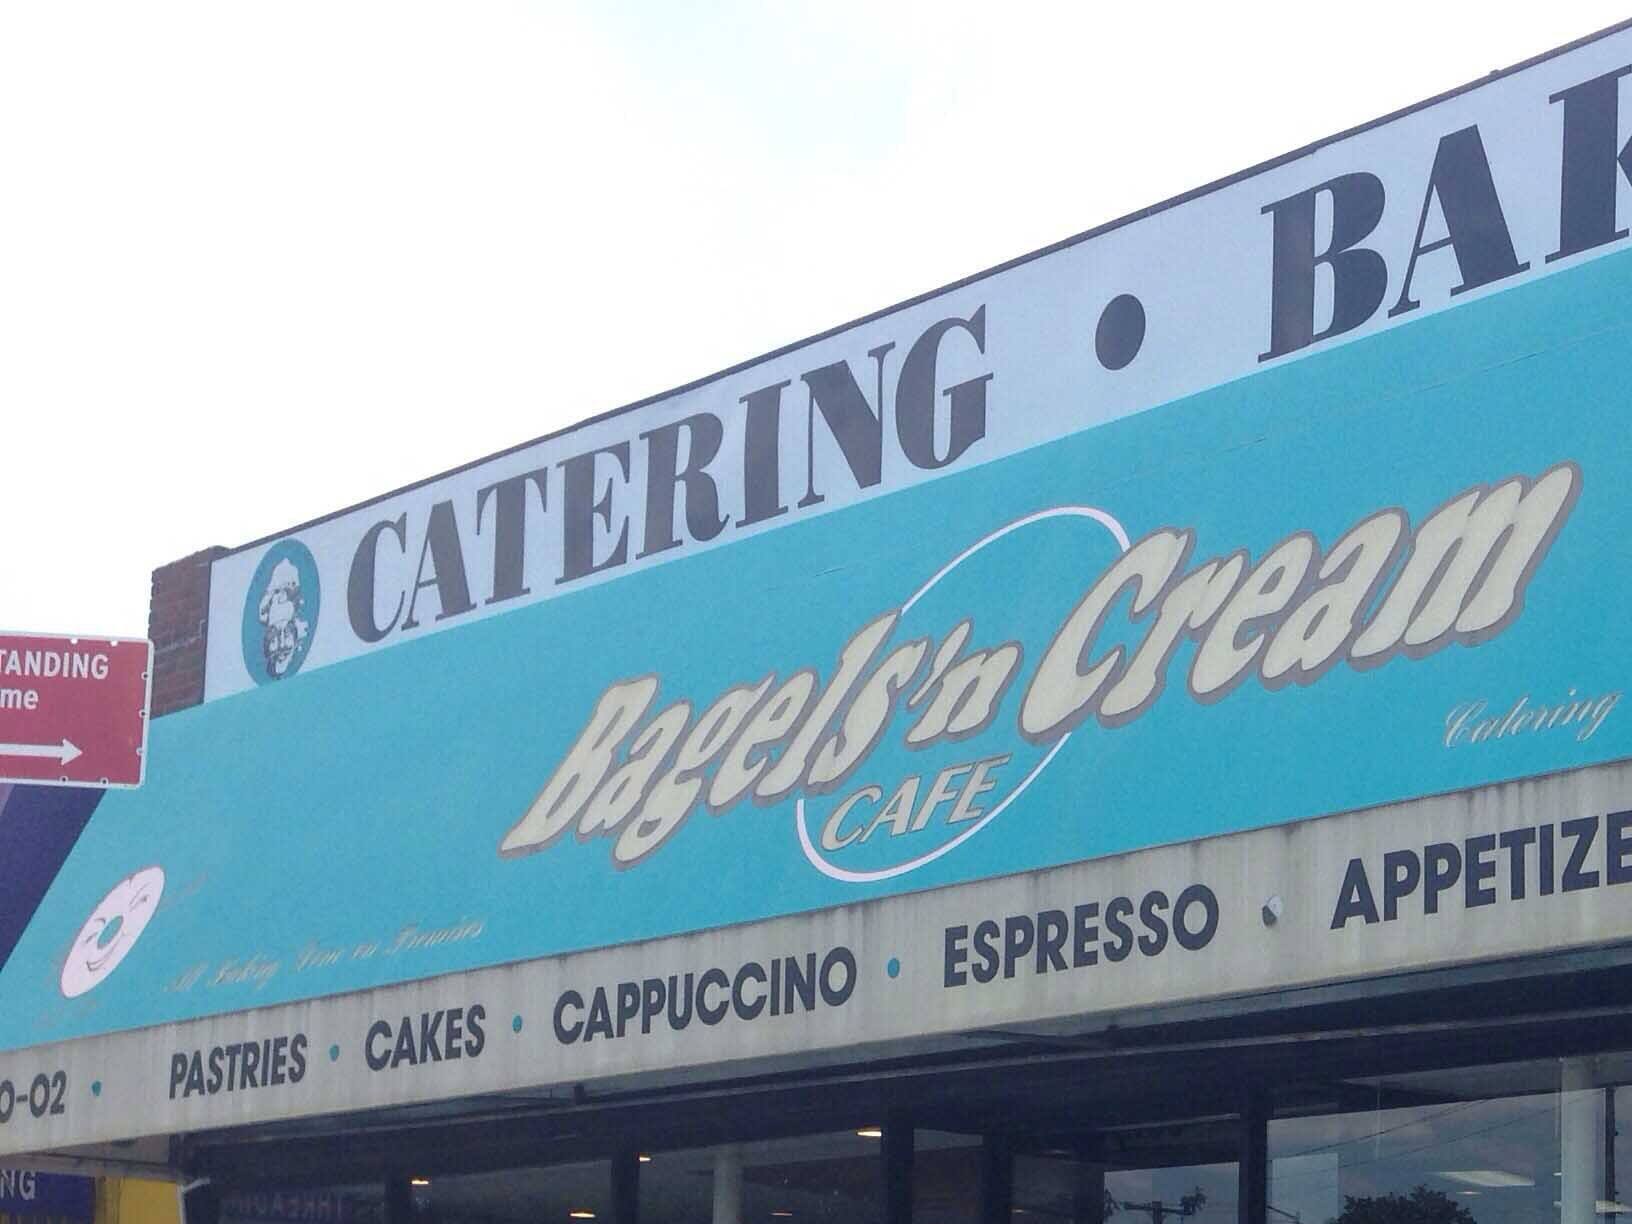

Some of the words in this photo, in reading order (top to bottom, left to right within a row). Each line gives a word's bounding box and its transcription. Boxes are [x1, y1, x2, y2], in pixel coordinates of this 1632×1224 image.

[346, 303, 995, 644] CATERING
[1018, 460, 1584, 748] Cream
[819, 754, 1010, 853] CAFE
[1443, 688, 1623, 749] Catering
[169, 1033, 308, 1100] PASTRIES
[365, 1003, 486, 1071] CAKES
[553, 946, 858, 1045] CAPPUCCINO
[943, 883, 1220, 988] ESPRESSO
